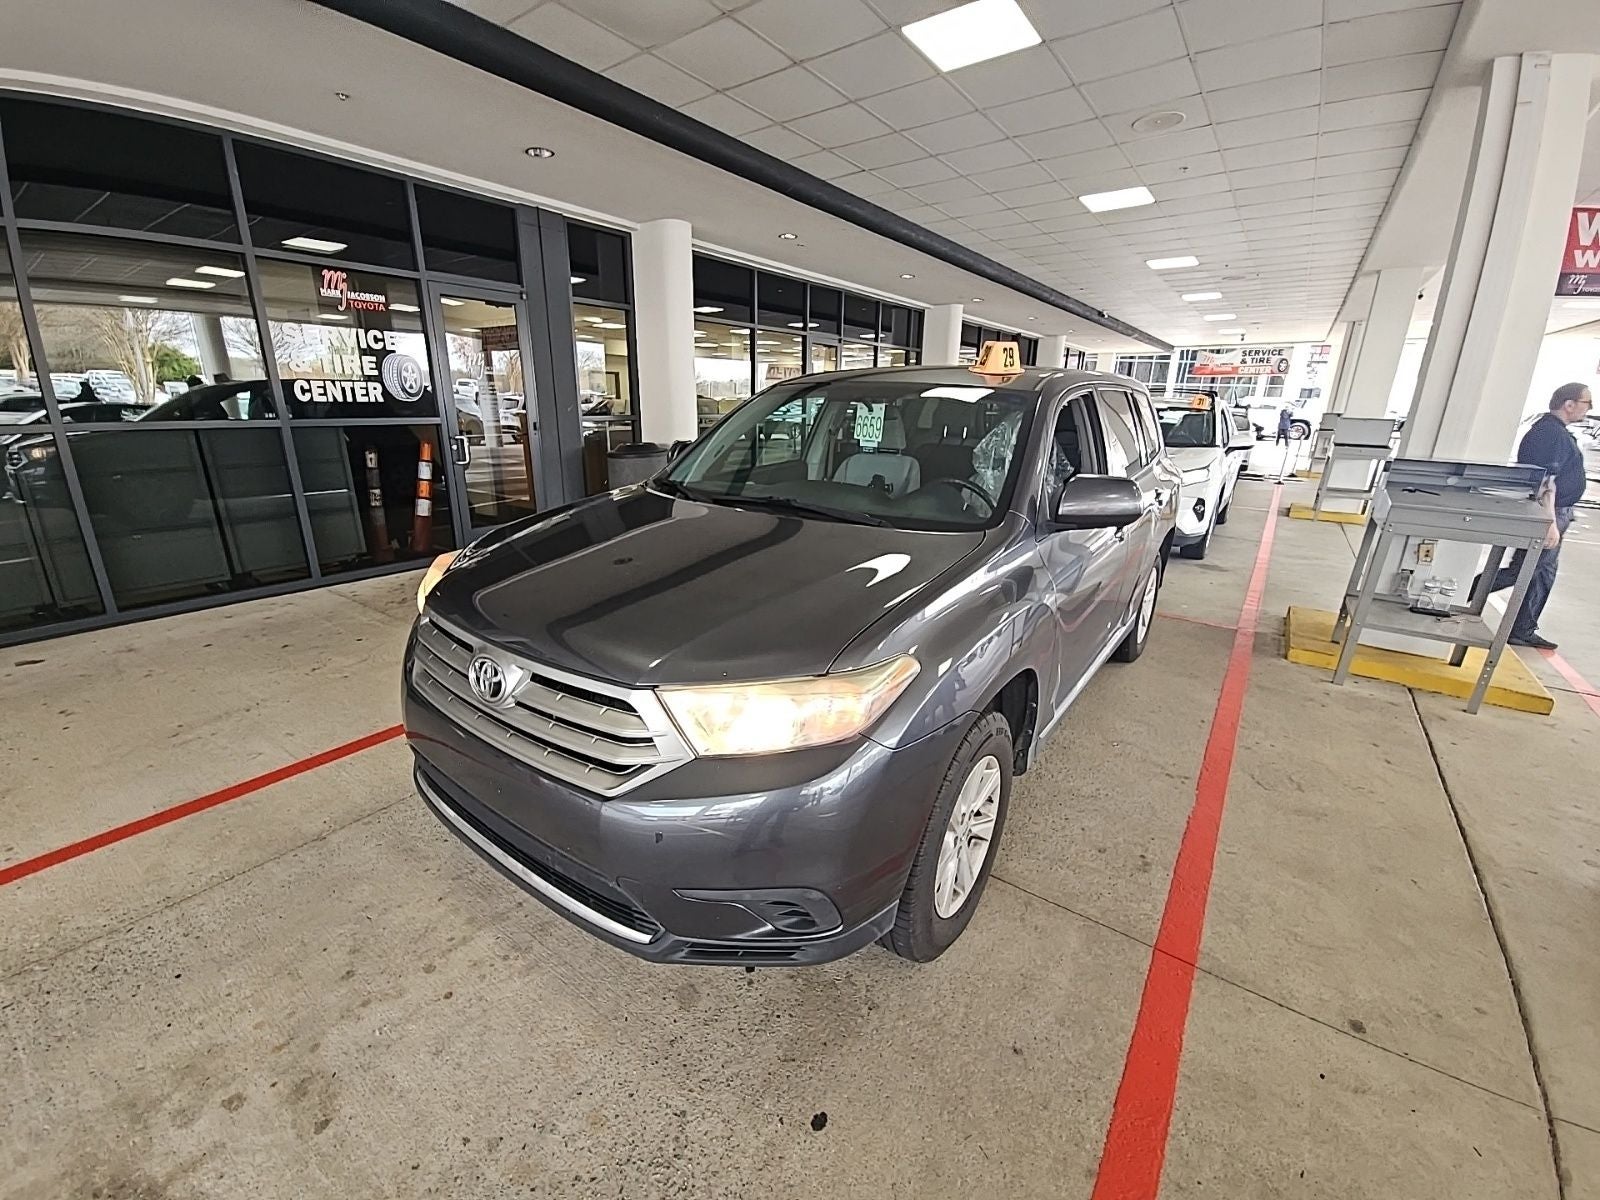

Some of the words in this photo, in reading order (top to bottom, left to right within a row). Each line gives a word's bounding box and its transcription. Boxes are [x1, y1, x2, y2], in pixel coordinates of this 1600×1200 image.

[349, 300, 386, 312] TOYOTA
[281, 322, 396, 351] SERVICE
[289, 350, 313, 373] &
[320, 351, 379, 376] TIRE
[1003, 347, 1014, 368] 29
[1241, 349, 1285, 357] SERVICE
[293, 379, 385, 403] CENTER
[856, 415, 882, 439] 6659
